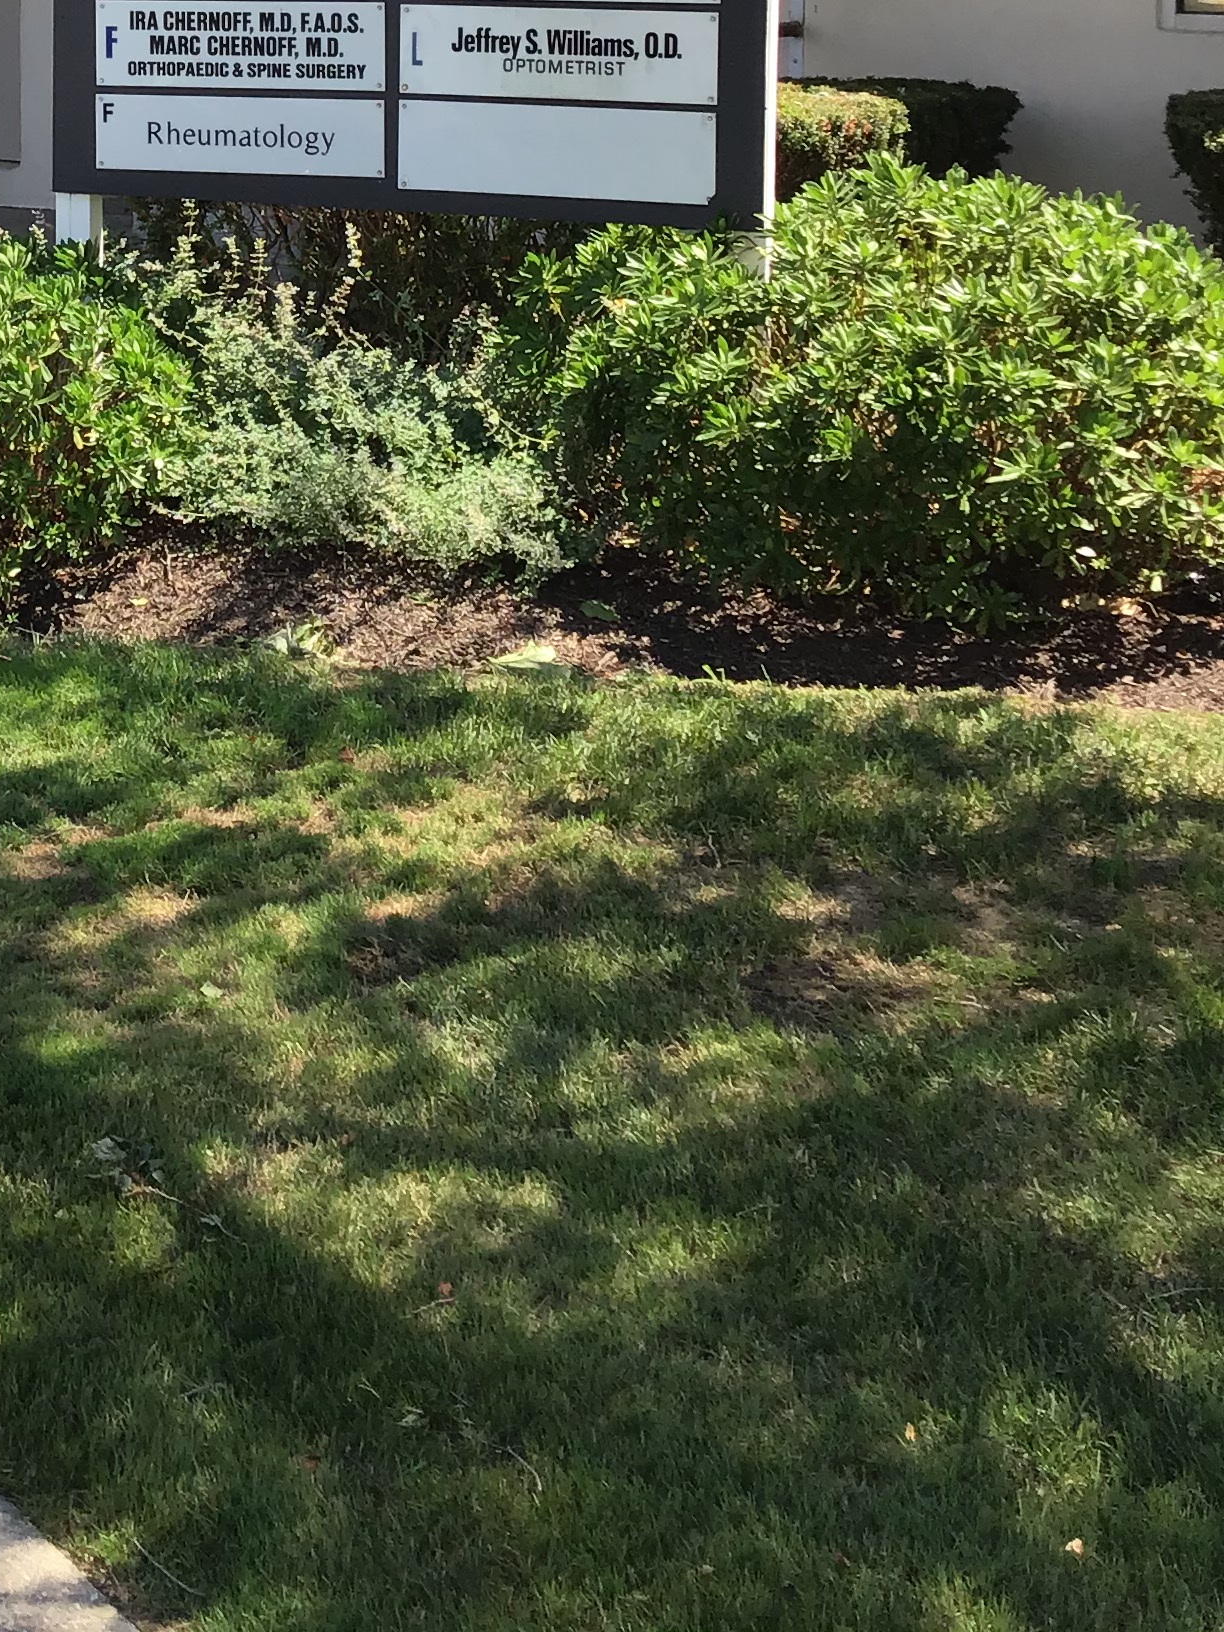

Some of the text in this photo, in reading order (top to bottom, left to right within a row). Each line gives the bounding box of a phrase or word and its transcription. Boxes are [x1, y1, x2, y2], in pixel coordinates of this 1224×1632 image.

[129, 11, 158, 31] IRA
[163, 11, 254, 34] CHERNOFF,
[300, 13, 364, 33] F.A.O.S.
[105, 26, 118, 59] F
[150, 35, 344, 60] MARC CHERNOFF, M.D.
[412, 32, 423, 66] L
[452, 27, 682, 60] Jeffrey S. Williams, O.D.
[128, 61, 366, 80] ORTHOPAEDIC & SPINE SURGERY
[503, 58, 625, 76] OPTOMETRIST
[103, 103, 114, 123] F
[147, 121, 335, 155] Rheumatology
